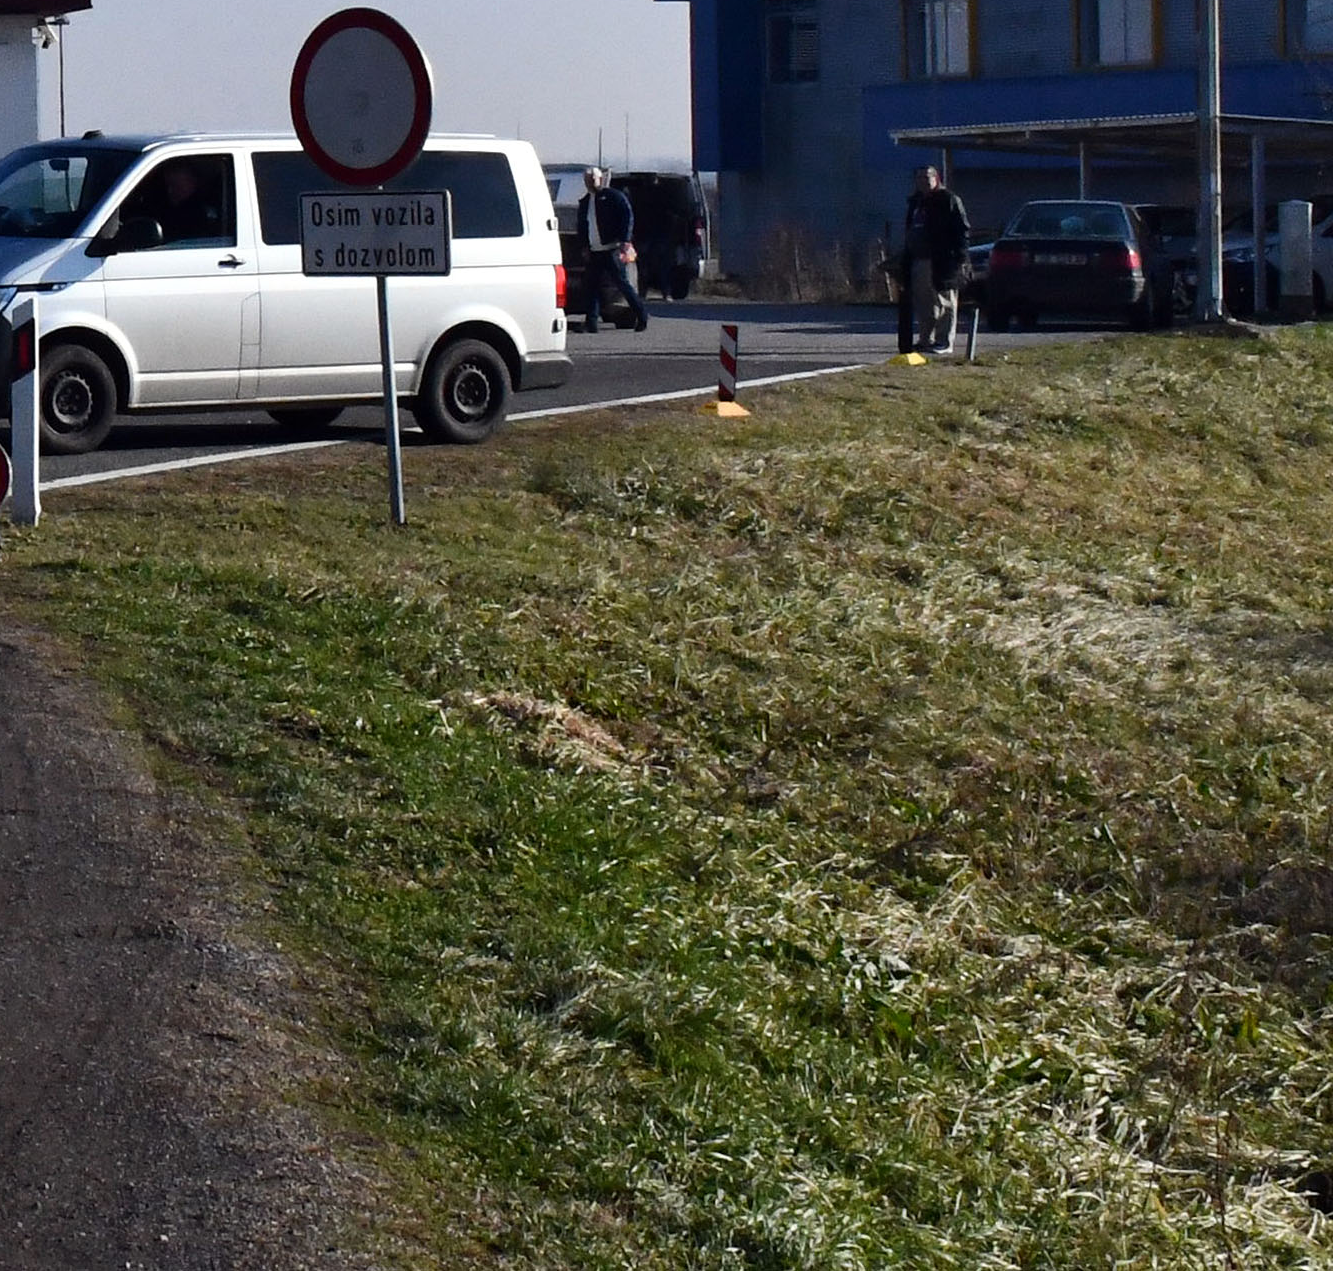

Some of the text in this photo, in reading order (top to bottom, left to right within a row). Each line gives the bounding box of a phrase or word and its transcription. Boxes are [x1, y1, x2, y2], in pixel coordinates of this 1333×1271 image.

[311, 200, 436, 228] Osim vozila
[314, 242, 436, 268] s dozvolom
